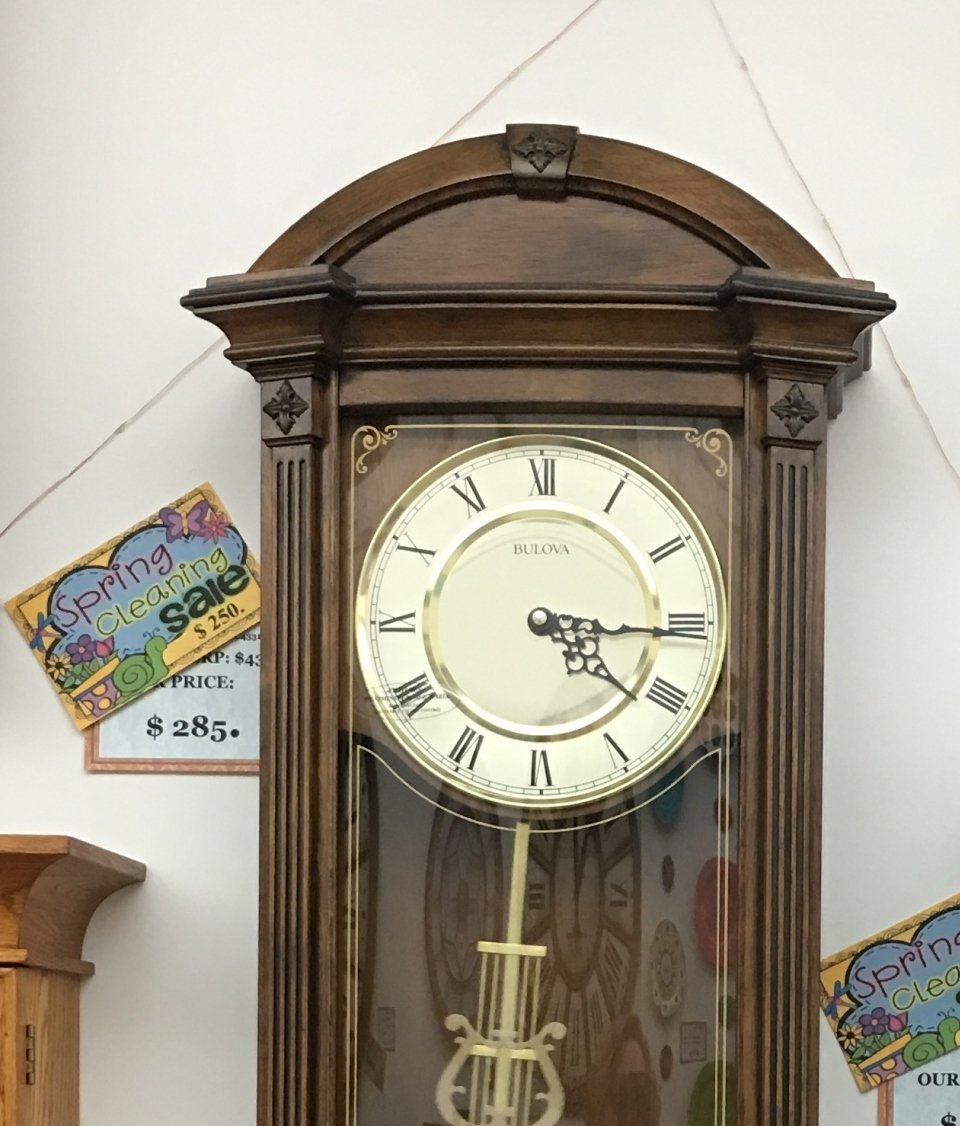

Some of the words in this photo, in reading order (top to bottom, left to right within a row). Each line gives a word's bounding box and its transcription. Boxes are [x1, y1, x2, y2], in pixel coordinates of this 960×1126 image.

[513, 543, 570, 556] BULOVA
[56, 543, 174, 628] Spring
[96, 547, 230, 636] Cleaning
[200, 651, 230, 664] RP:
[171, 675, 235, 690] PRICE:
[917, 1072, 960, 1087] OUR
